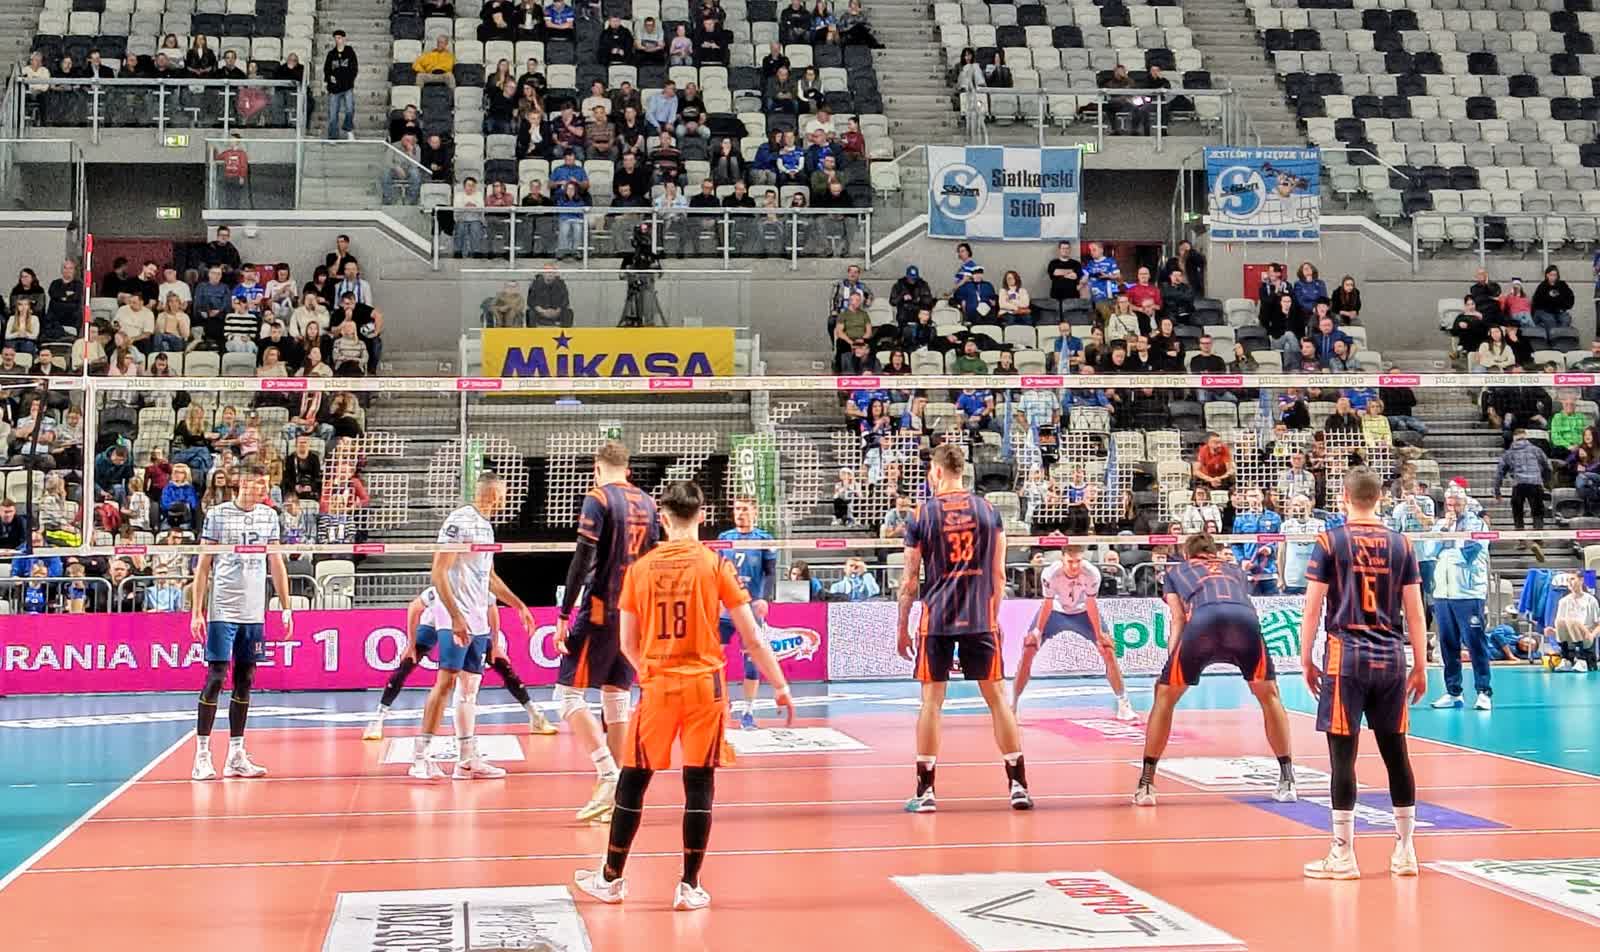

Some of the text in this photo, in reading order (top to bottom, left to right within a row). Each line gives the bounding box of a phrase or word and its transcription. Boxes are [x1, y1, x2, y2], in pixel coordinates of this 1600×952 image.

[1010, 198, 1056, 218] Stilon
[736, 553, 747, 568] 7
[951, 531, 974, 563] 33
[1362, 576, 1378, 614] 6
[657, 601, 687, 640] 18
[0, 642, 138, 671] RANIA
[151, 637, 302, 668] NAET
[769, 635, 804, 653] OTTO
[1112, 612, 1165, 667] pl
